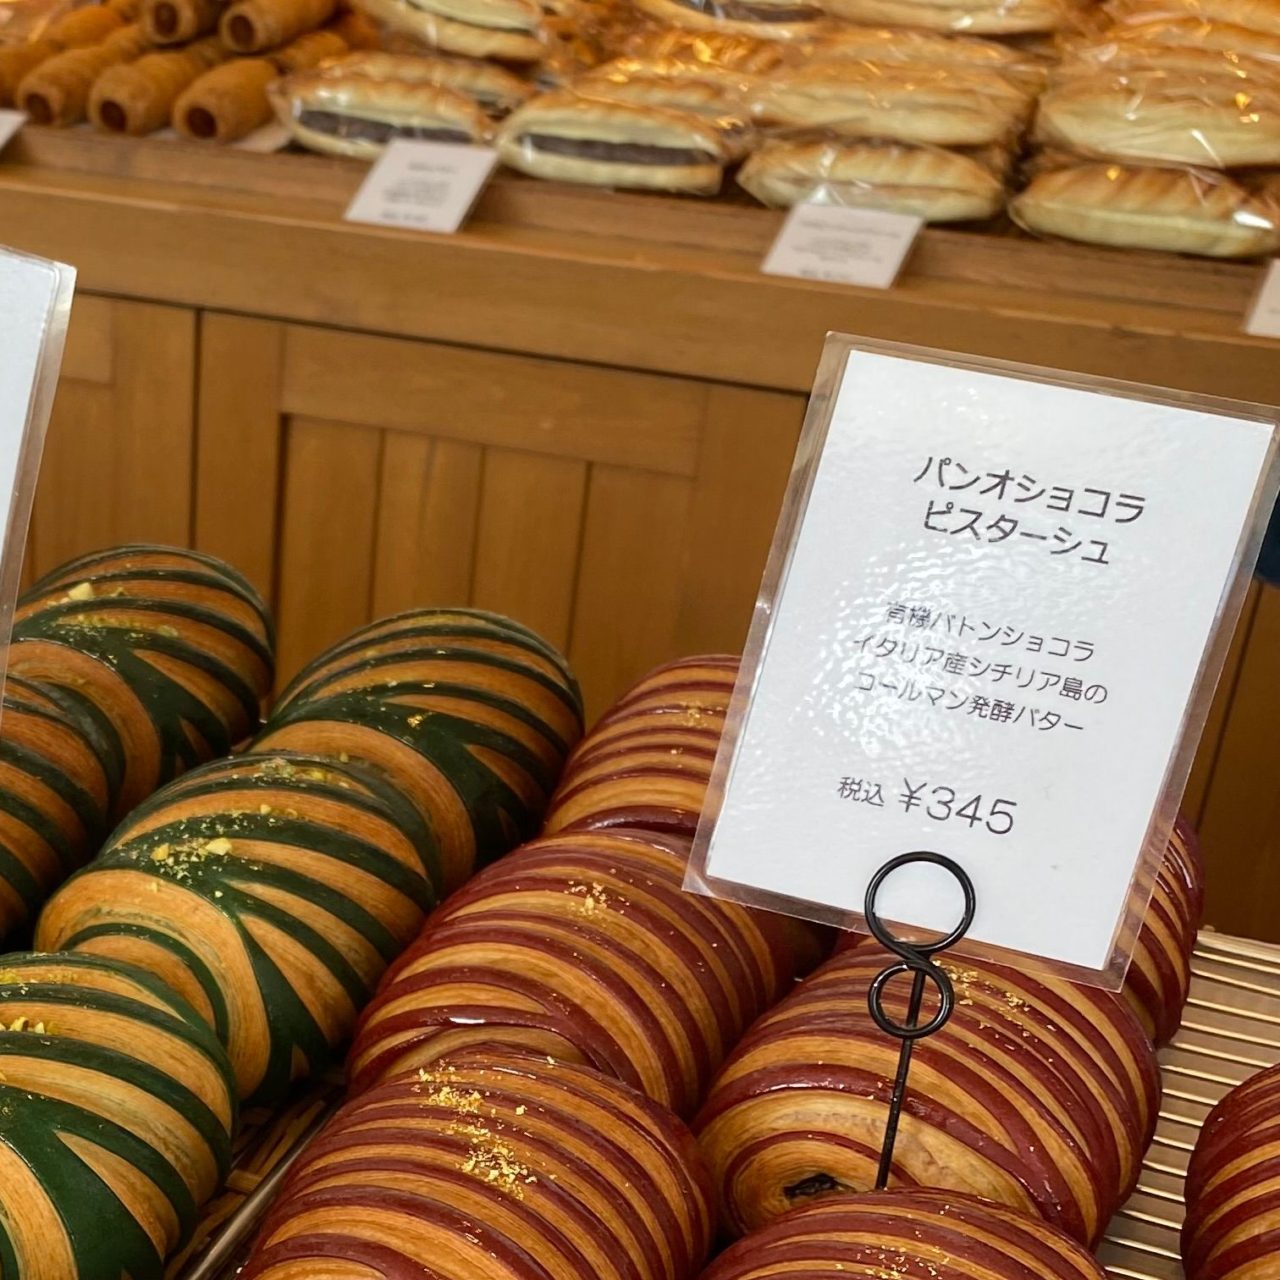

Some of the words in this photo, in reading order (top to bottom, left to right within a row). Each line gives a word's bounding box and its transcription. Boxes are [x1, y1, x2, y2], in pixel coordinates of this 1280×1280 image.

[913, 456, 1147, 523] パンオショコラ
[924, 500, 1109, 565] ピスターシュ
[853, 634, 1108, 704] イタリア産シチリア島の
[837, 777, 886, 808] 税込
[898, 777, 1018, 836] ¥345
